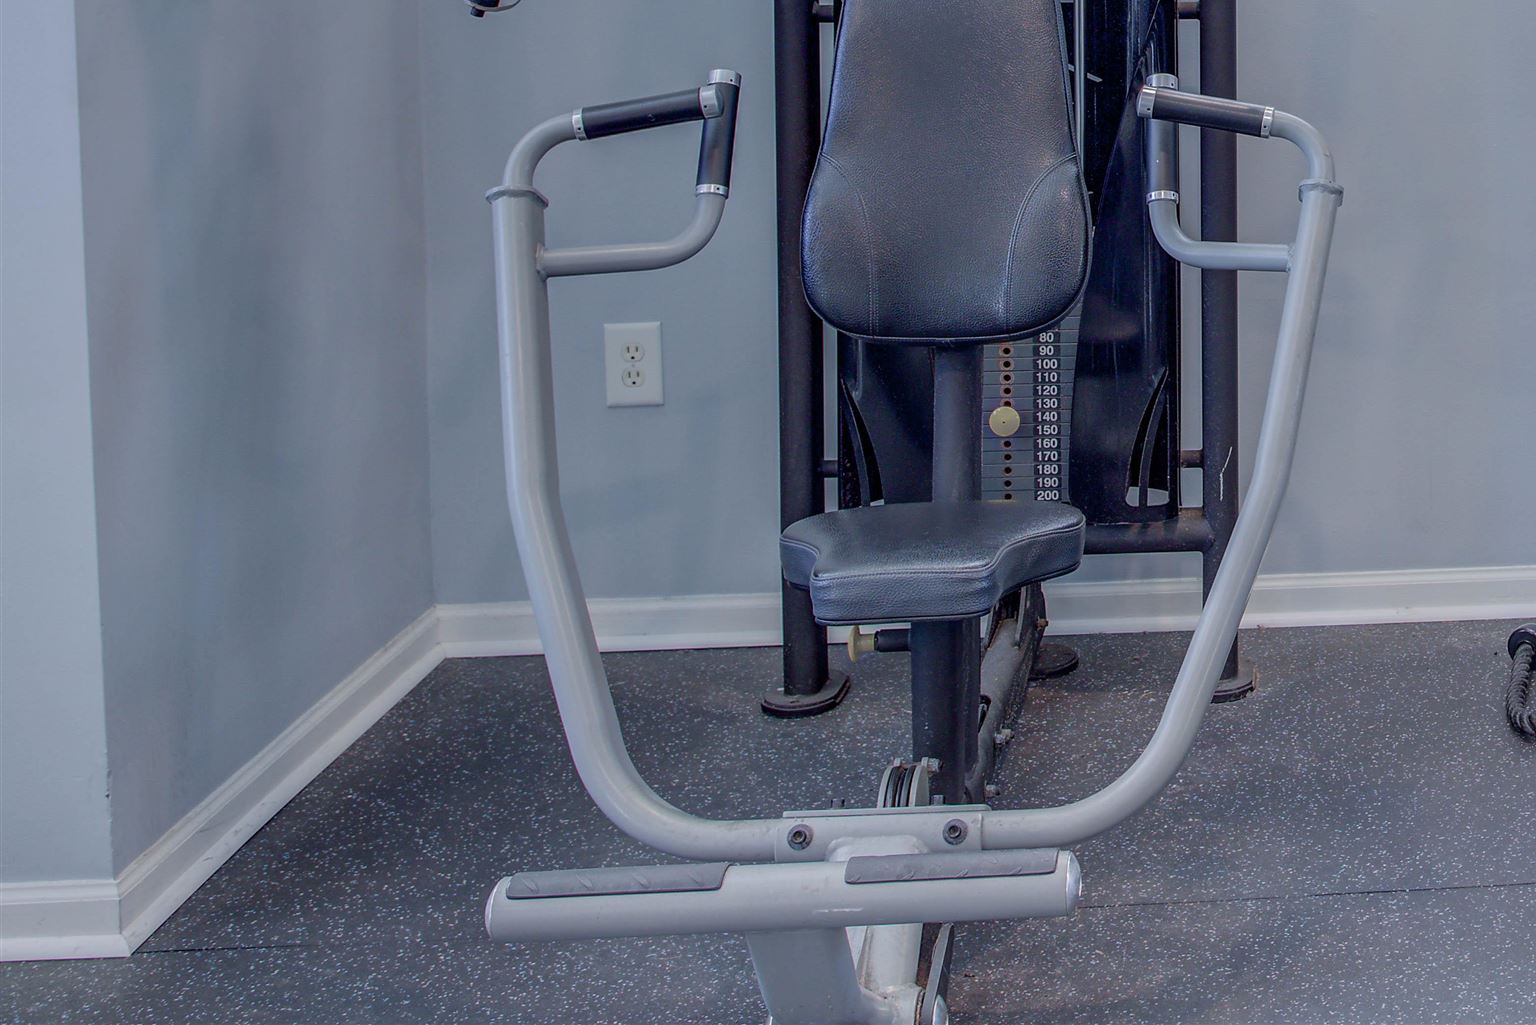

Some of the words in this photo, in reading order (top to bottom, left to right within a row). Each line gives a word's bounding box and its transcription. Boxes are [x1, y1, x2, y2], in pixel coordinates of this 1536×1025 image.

[1039, 332, 1054, 343] 80
[1039, 345, 1054, 355] 90
[1036, 358, 1058, 369] 100
[1036, 372, 1058, 382] 110
[1036, 385, 1058, 395] 120
[1036, 398, 1058, 408] 130
[1036, 411, 1058, 421] 140
[1036, 424, 1058, 435] 150
[1036, 438, 1058, 448] 160
[1036, 451, 1058, 461] 170
[1037, 464, 1058, 474] 180
[1037, 477, 1059, 487] 190
[1037, 490, 1059, 500] 200
